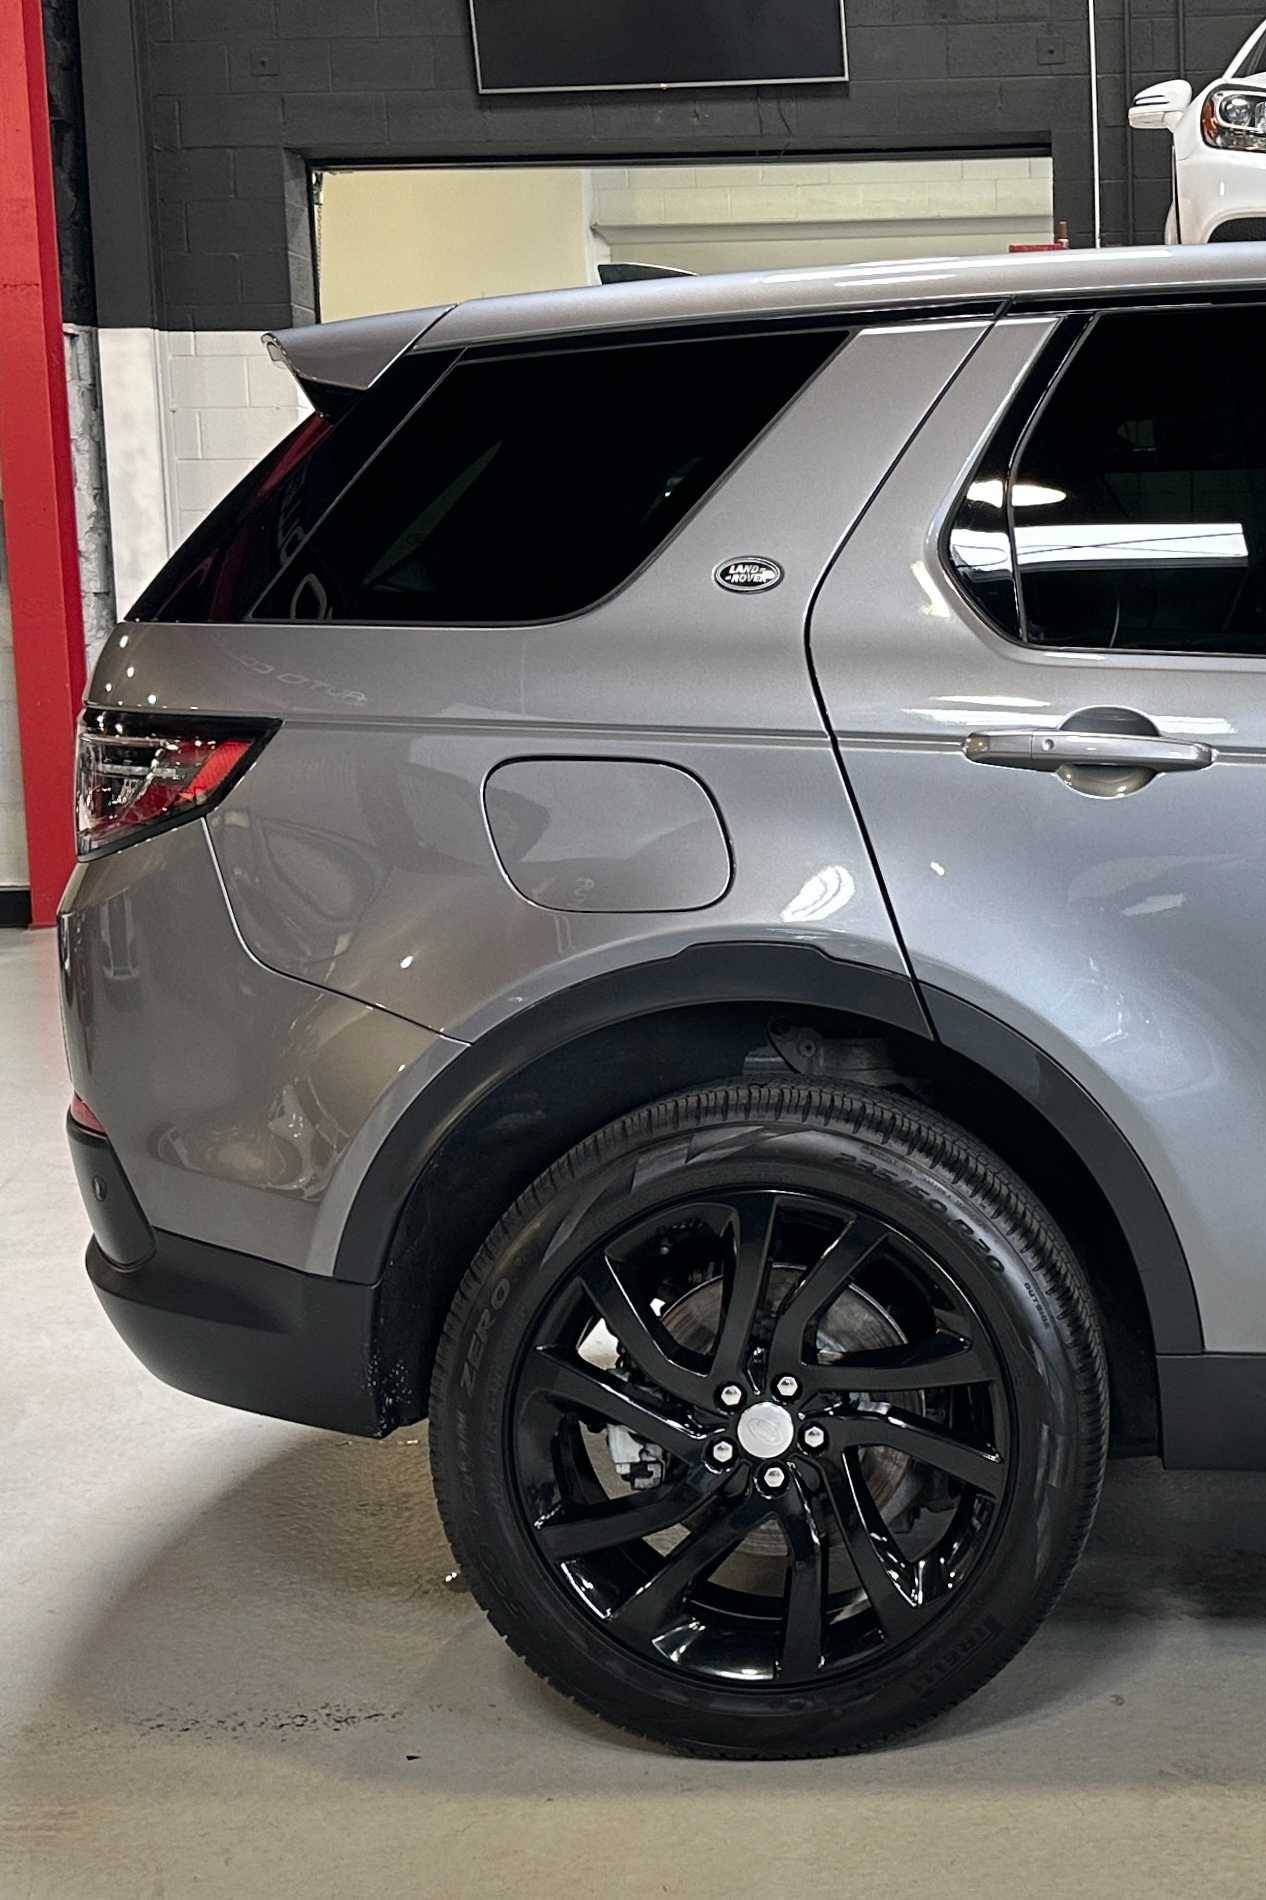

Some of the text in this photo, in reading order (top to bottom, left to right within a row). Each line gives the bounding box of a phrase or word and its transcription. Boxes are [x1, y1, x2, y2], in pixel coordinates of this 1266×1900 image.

[729, 564, 759, 574] LAND
[731, 573, 767, 583] ROVER
[460, 1279, 510, 1398] ZERO
